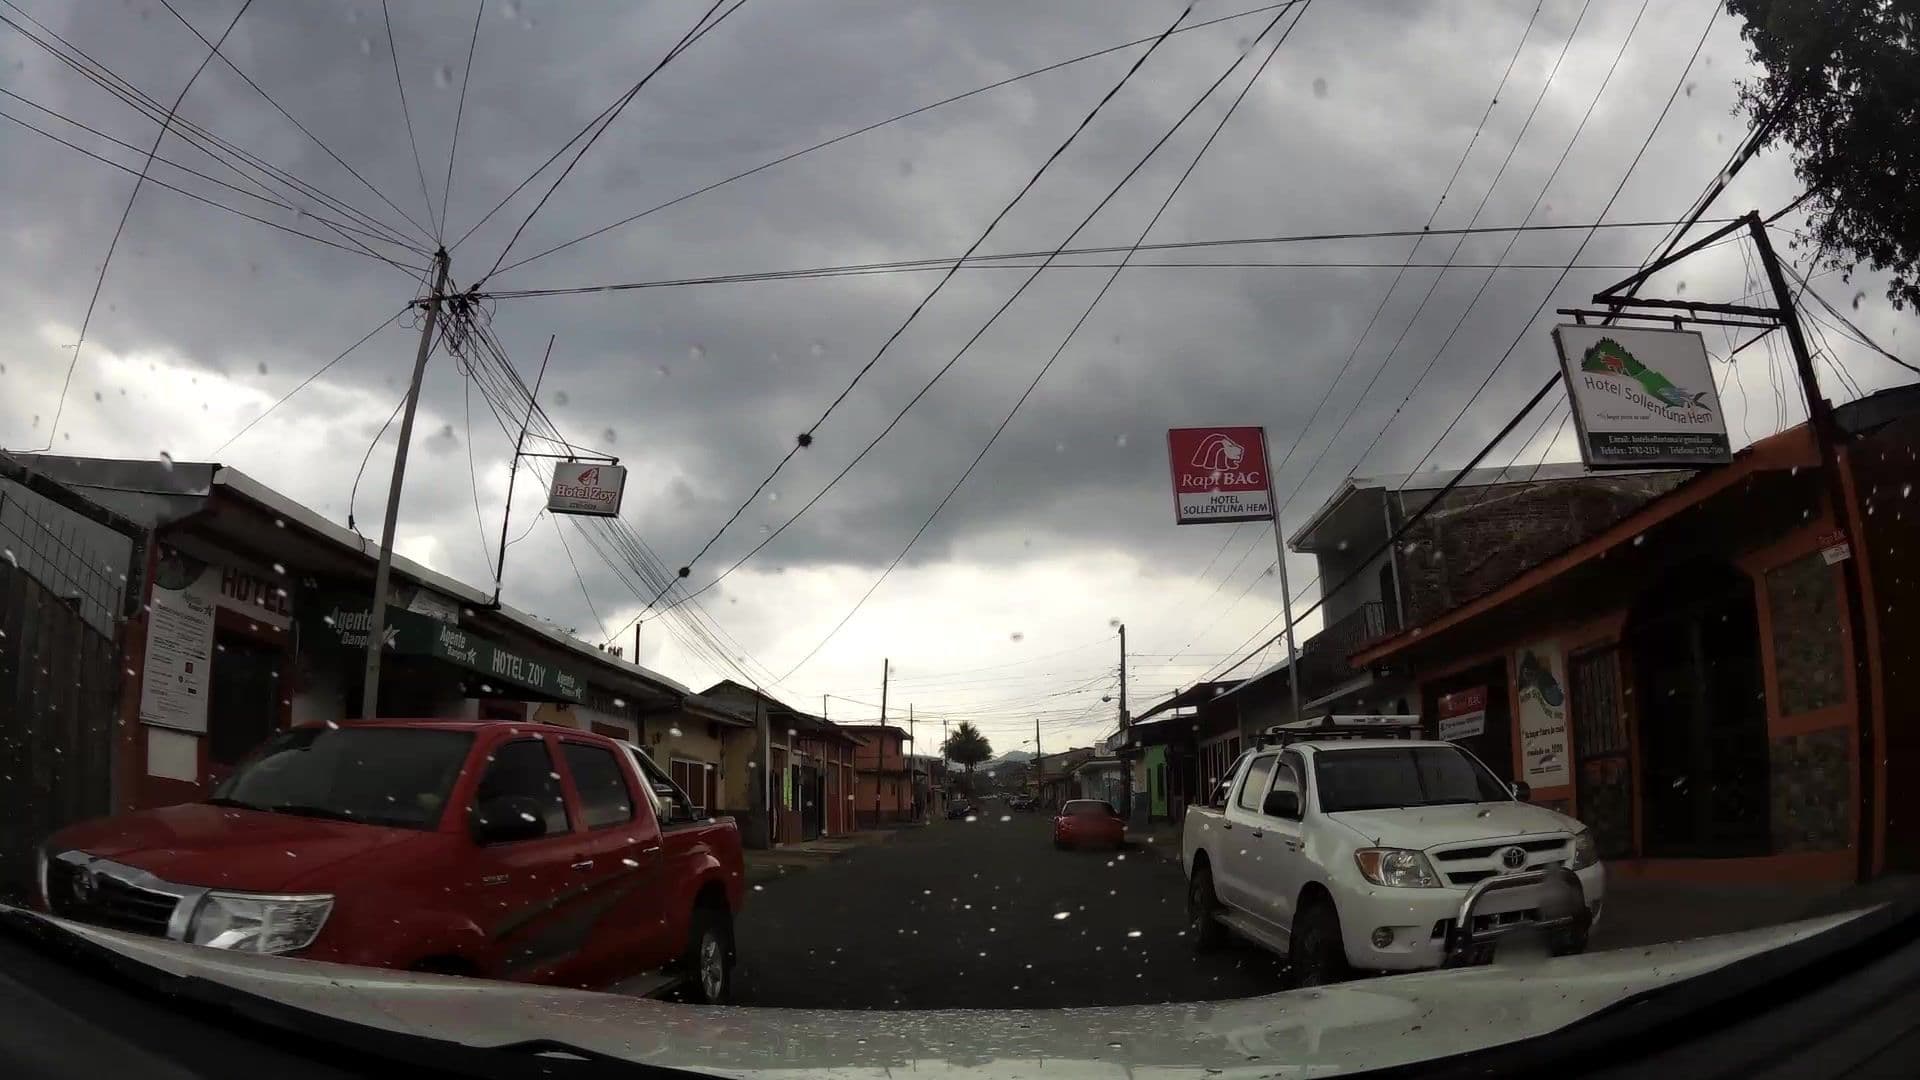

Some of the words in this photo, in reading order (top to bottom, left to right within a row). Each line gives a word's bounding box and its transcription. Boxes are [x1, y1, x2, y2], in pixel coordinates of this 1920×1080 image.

[1584, 376, 1621, 397] Hotel
[1624, 387, 1687, 424] Sollentuna
[1688, 411, 1713, 424] Hem
[1182, 473, 1219, 489] Rapi
[1223, 471, 1260, 486] BAC
[556, 484, 588, 498] Hotel
[589, 486, 616, 504] Zoy
[1210, 495, 1240, 505] HOTEL
[1183, 504, 1244, 515] SOLLENTUNA
[1246, 503, 1268, 512] HEM
[221, 566, 289, 617] HOTEL
[341, 631, 369, 649] Banp
[439, 624, 467, 649] Agente
[492, 648, 525, 681] HOTEL
[527, 662, 547, 688] ZOY
